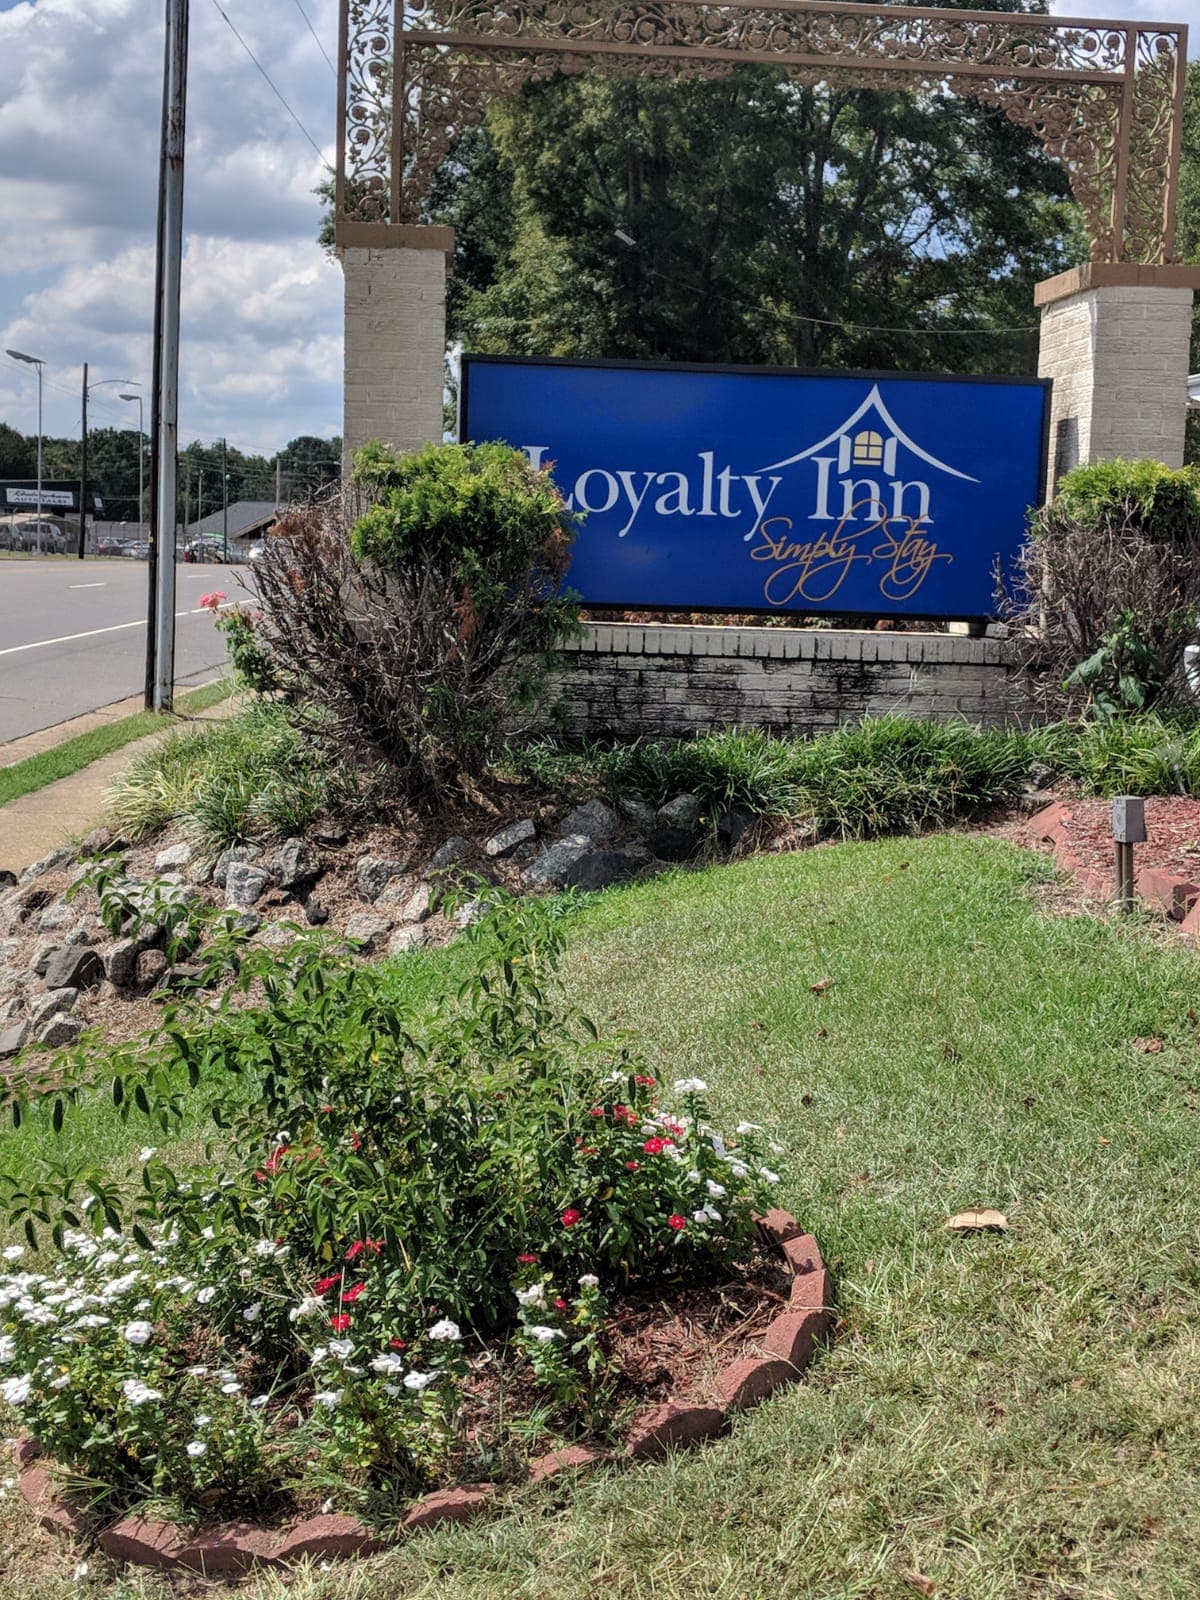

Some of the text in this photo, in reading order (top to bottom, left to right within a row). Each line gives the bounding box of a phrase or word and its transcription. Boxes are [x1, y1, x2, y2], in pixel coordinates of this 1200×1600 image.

[809, 457, 933, 522] Inn
[750, 499, 953, 605] Simply Stay
